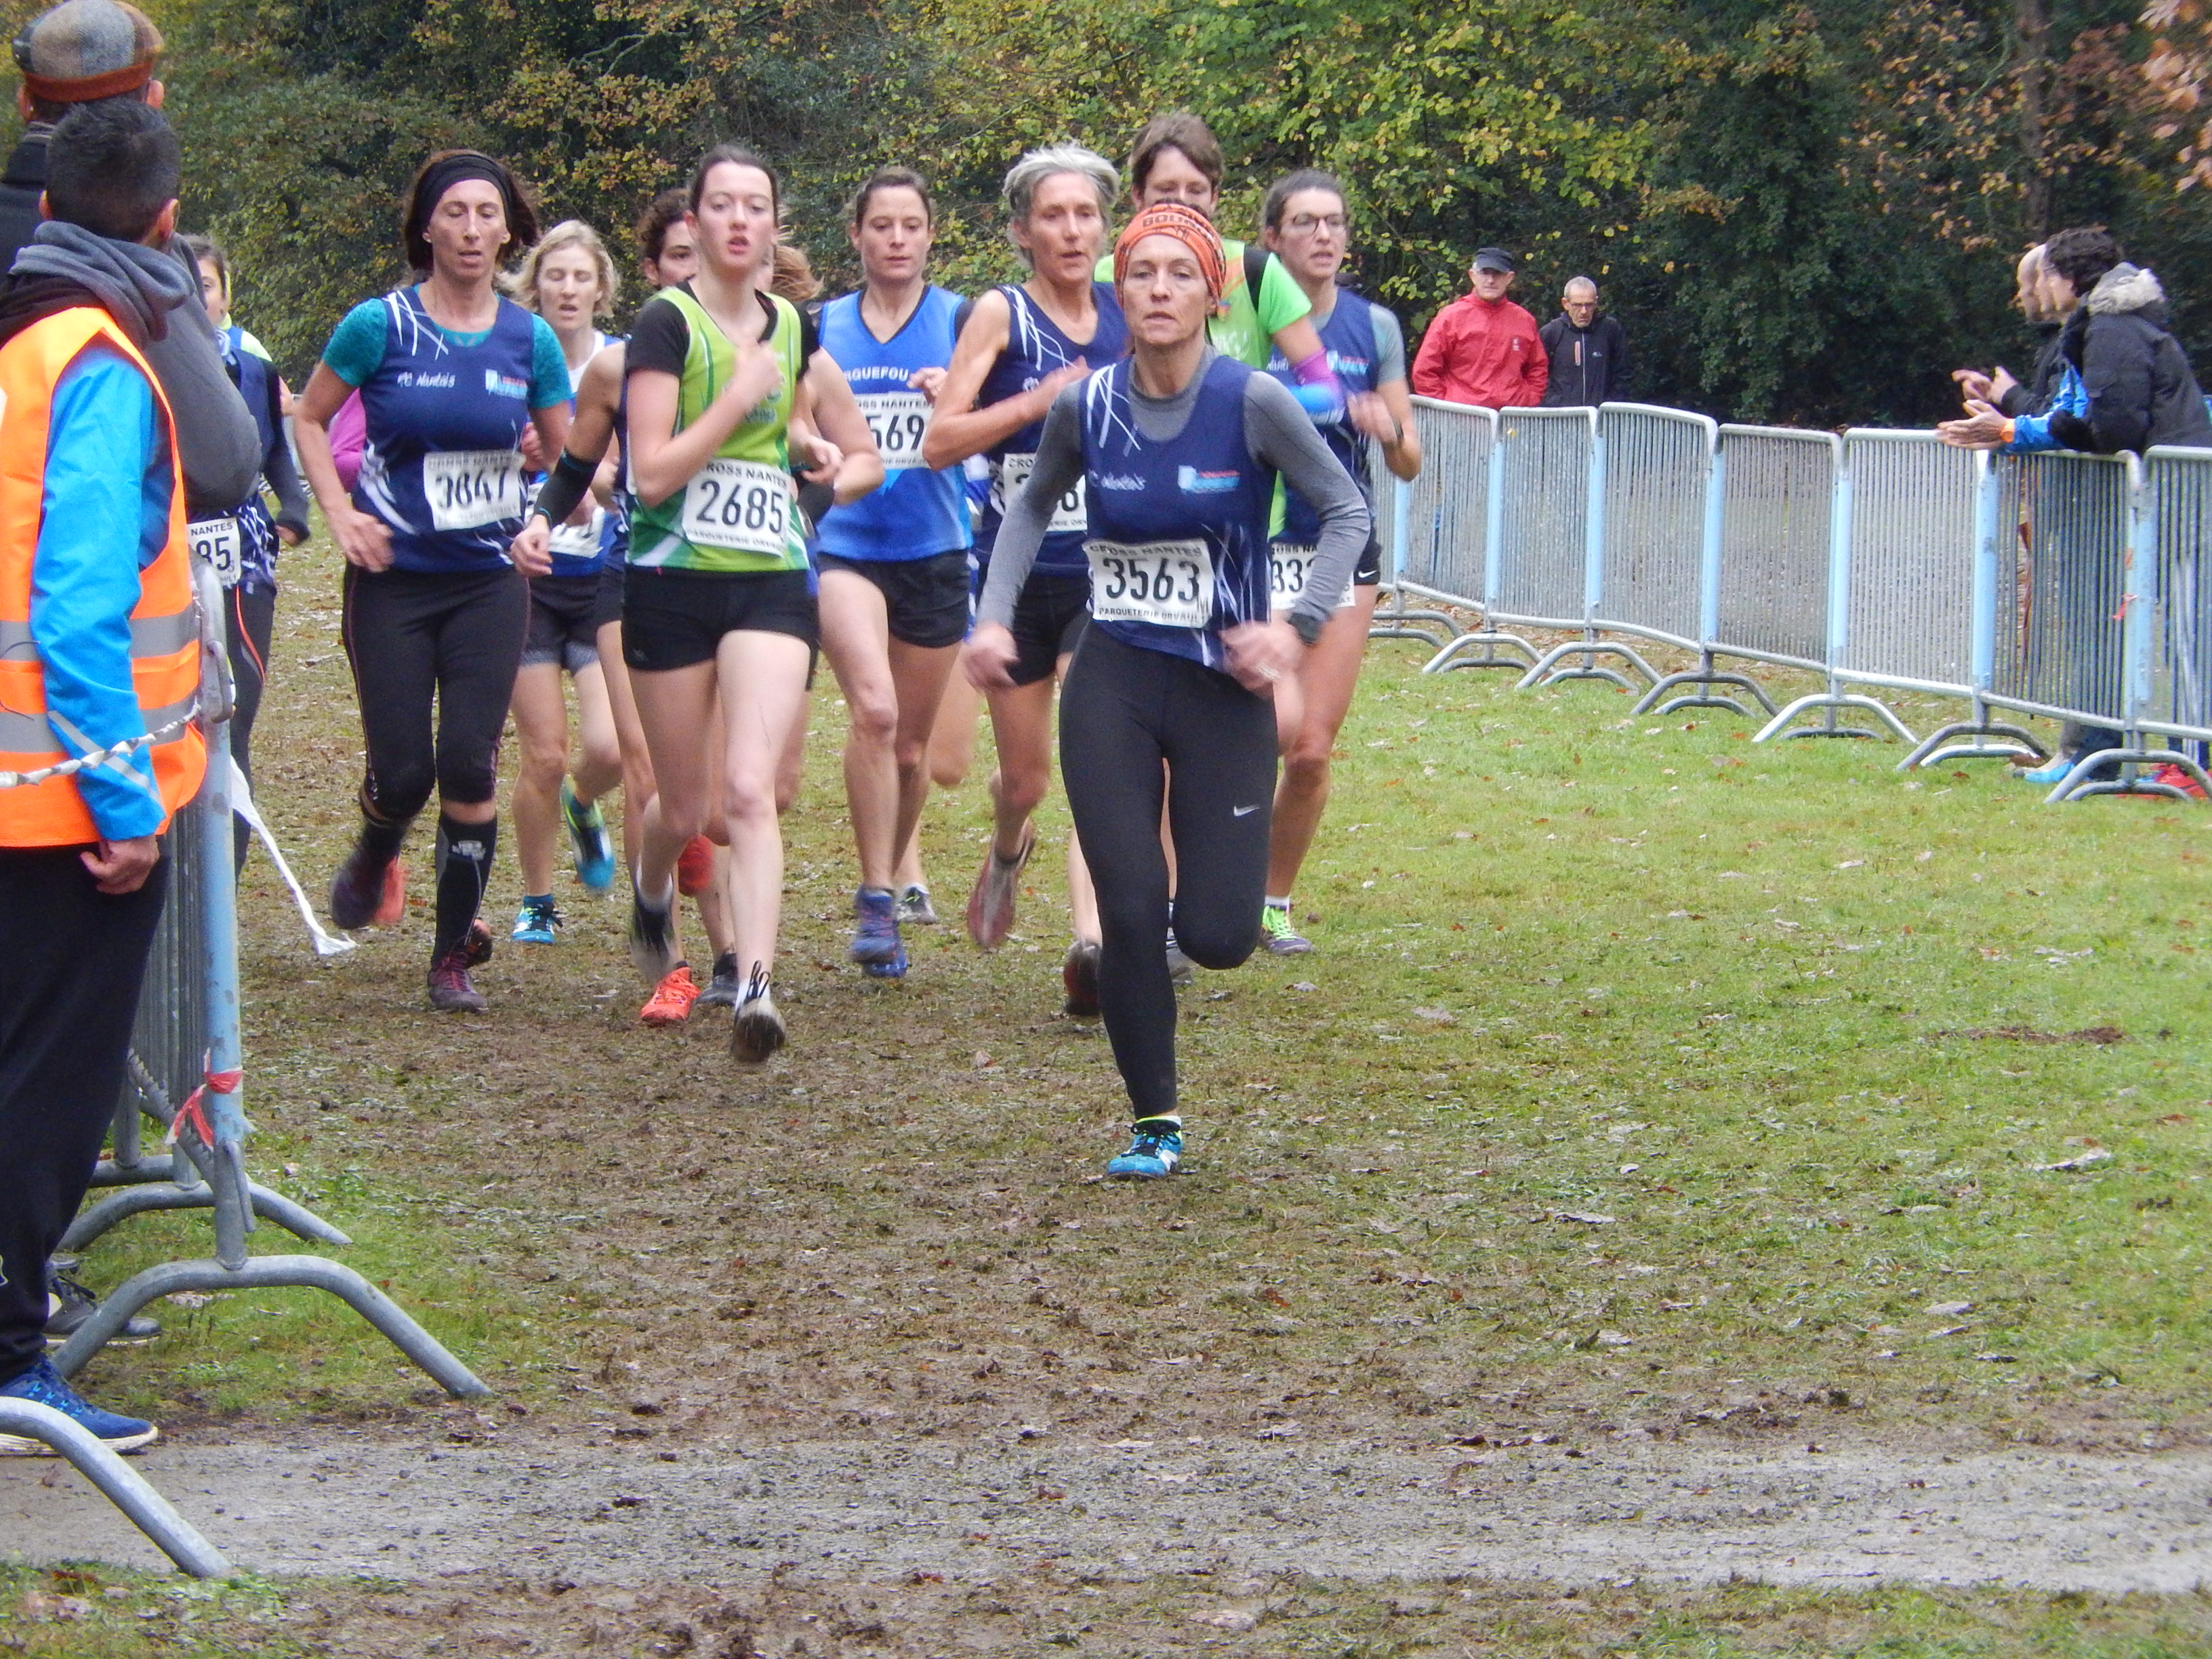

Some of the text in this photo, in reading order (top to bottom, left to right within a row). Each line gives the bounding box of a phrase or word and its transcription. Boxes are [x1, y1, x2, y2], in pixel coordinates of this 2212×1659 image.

[844, 367, 909, 382] RQUEFOU
[865, 414, 924, 451] 569
[1008, 458, 1034, 468] CRO
[705, 462, 787, 489] ROSS NANTES
[697, 480, 783, 534] 2685
[191, 521, 233, 536] NANTES
[197, 536, 230, 571] 85
[1089, 544, 1202, 557] CROSS NANTES
[1103, 558, 1200, 602] 3563
[1099, 607, 1160, 619] PARQUETERIE
